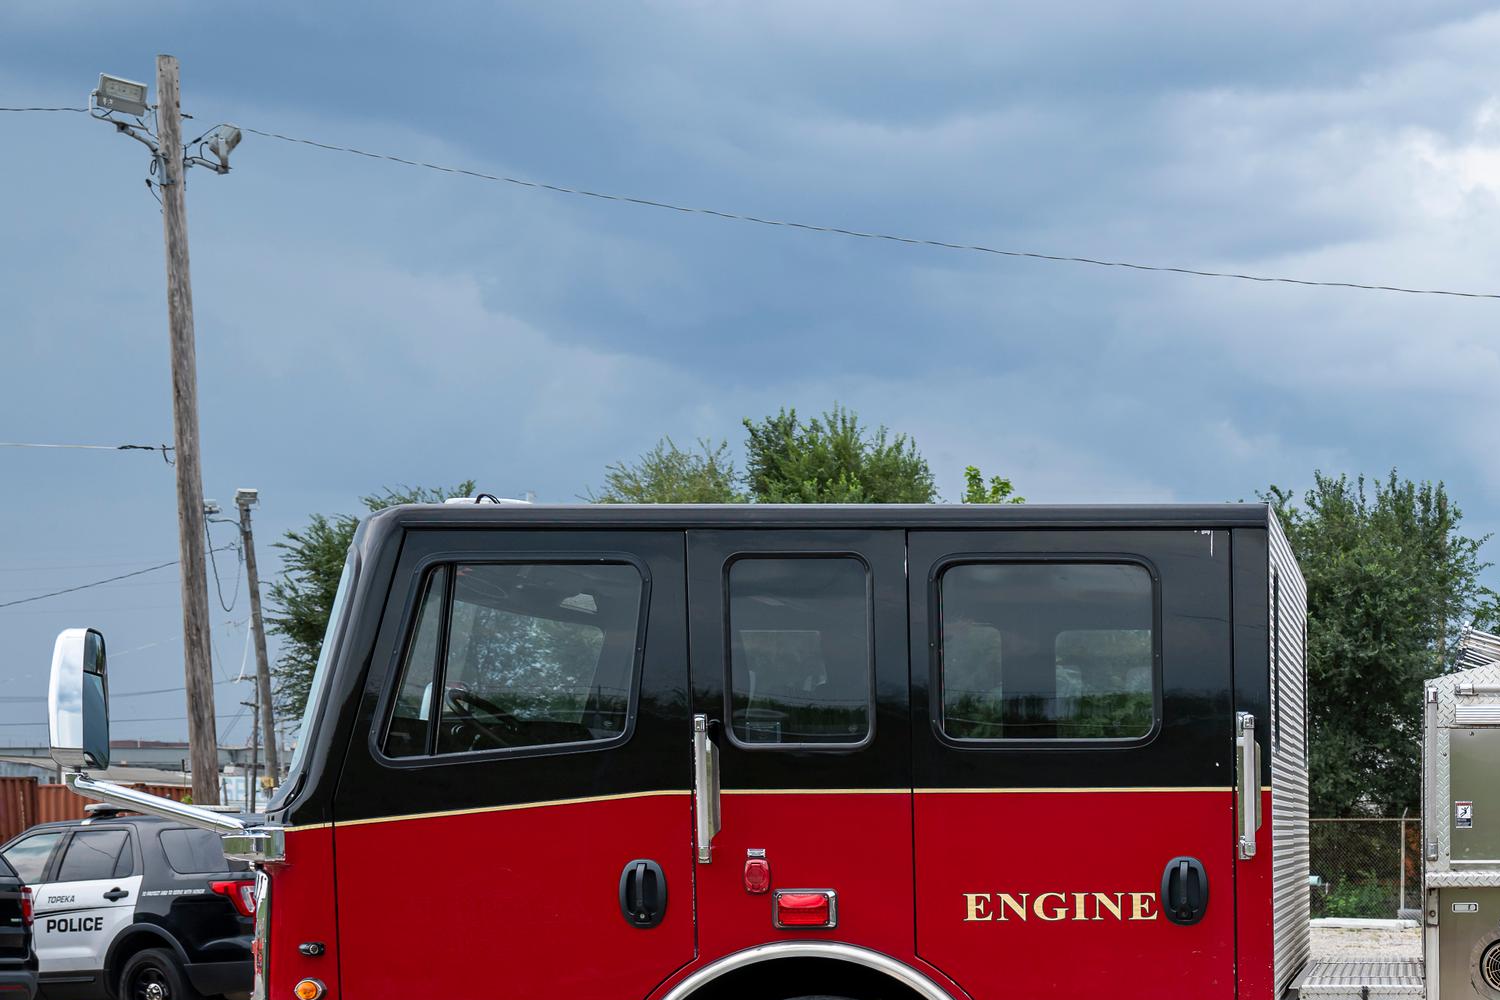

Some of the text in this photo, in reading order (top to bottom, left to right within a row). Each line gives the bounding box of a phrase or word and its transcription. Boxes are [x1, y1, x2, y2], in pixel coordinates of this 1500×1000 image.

[47, 895, 76, 904] TOPEKA
[963, 892, 1159, 922] ENGINE
[46, 916, 104, 933] POLICE
